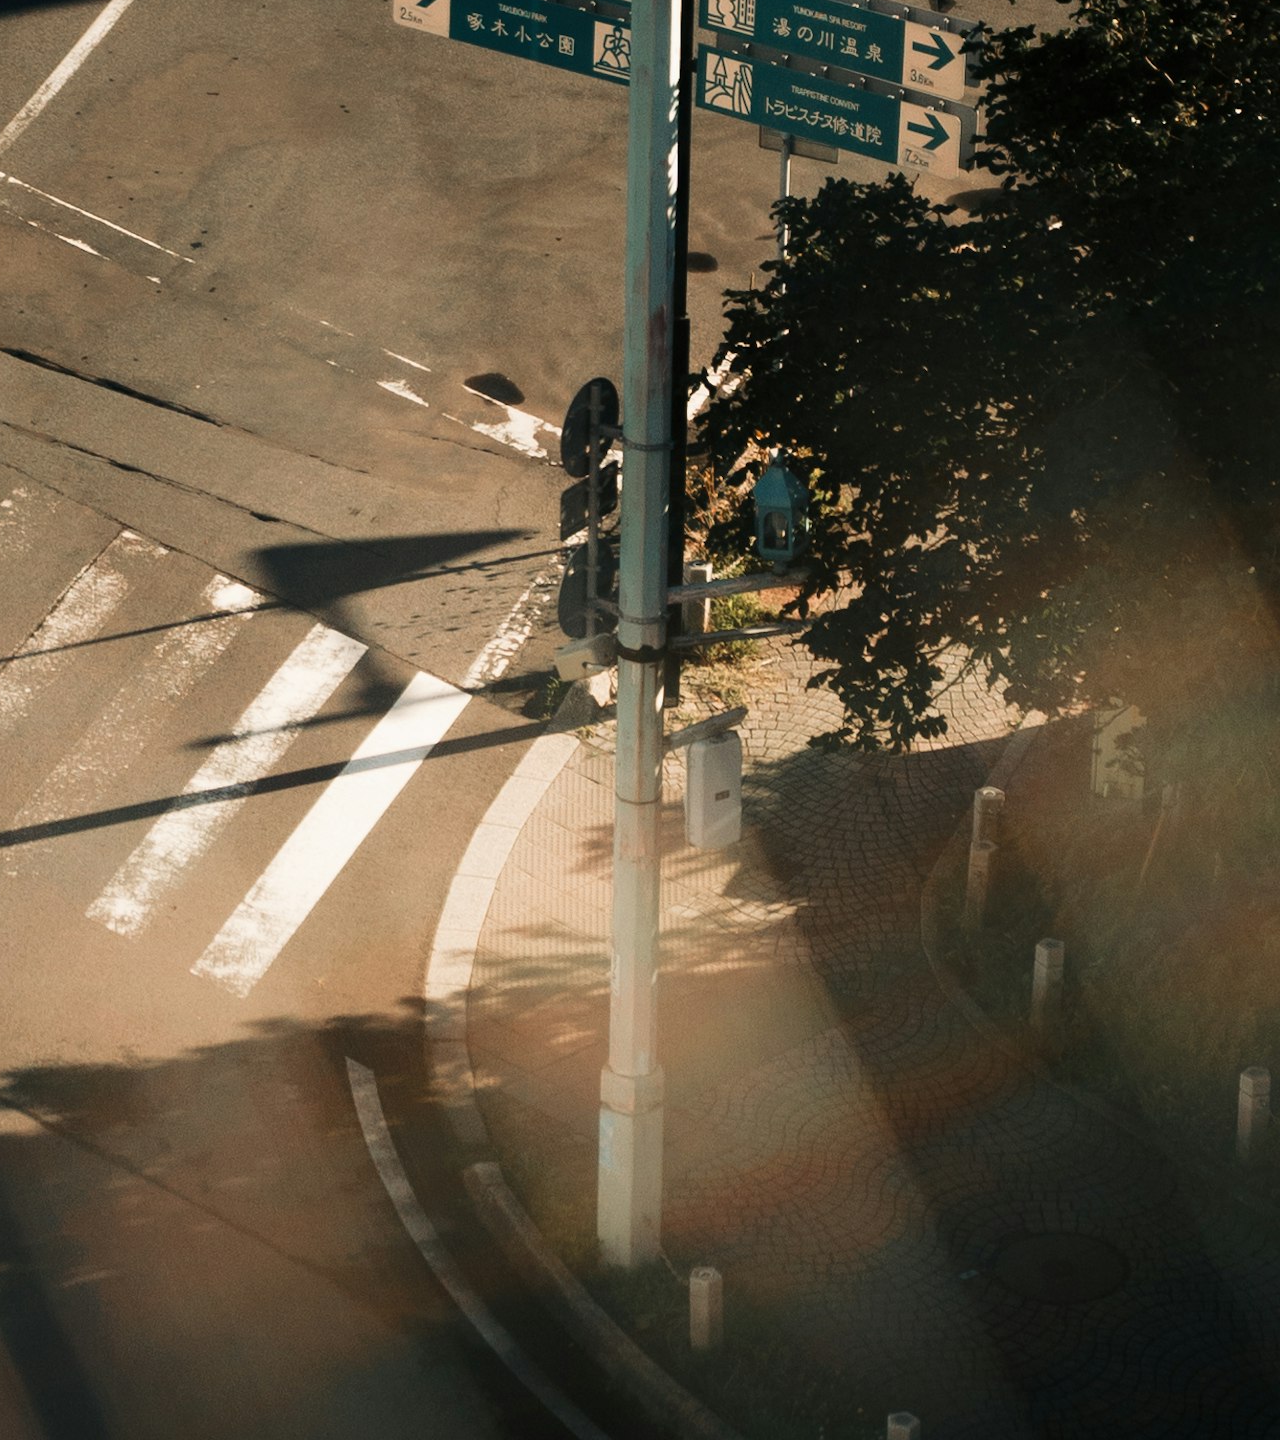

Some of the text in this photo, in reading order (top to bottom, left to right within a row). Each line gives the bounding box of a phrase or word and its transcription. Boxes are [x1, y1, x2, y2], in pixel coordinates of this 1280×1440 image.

[498, 3, 548, 24] TAKUBOKU PARK
[792, 5, 867, 33] YUNOKAWA SPA RESORT
[467, 12, 575, 56] 啄木小公園
[772, 16, 884, 64] 湯の川温泉
[764, 96, 883, 147] トラピスチヌ修道院
[830, 95, 860, 113] CONVENT
